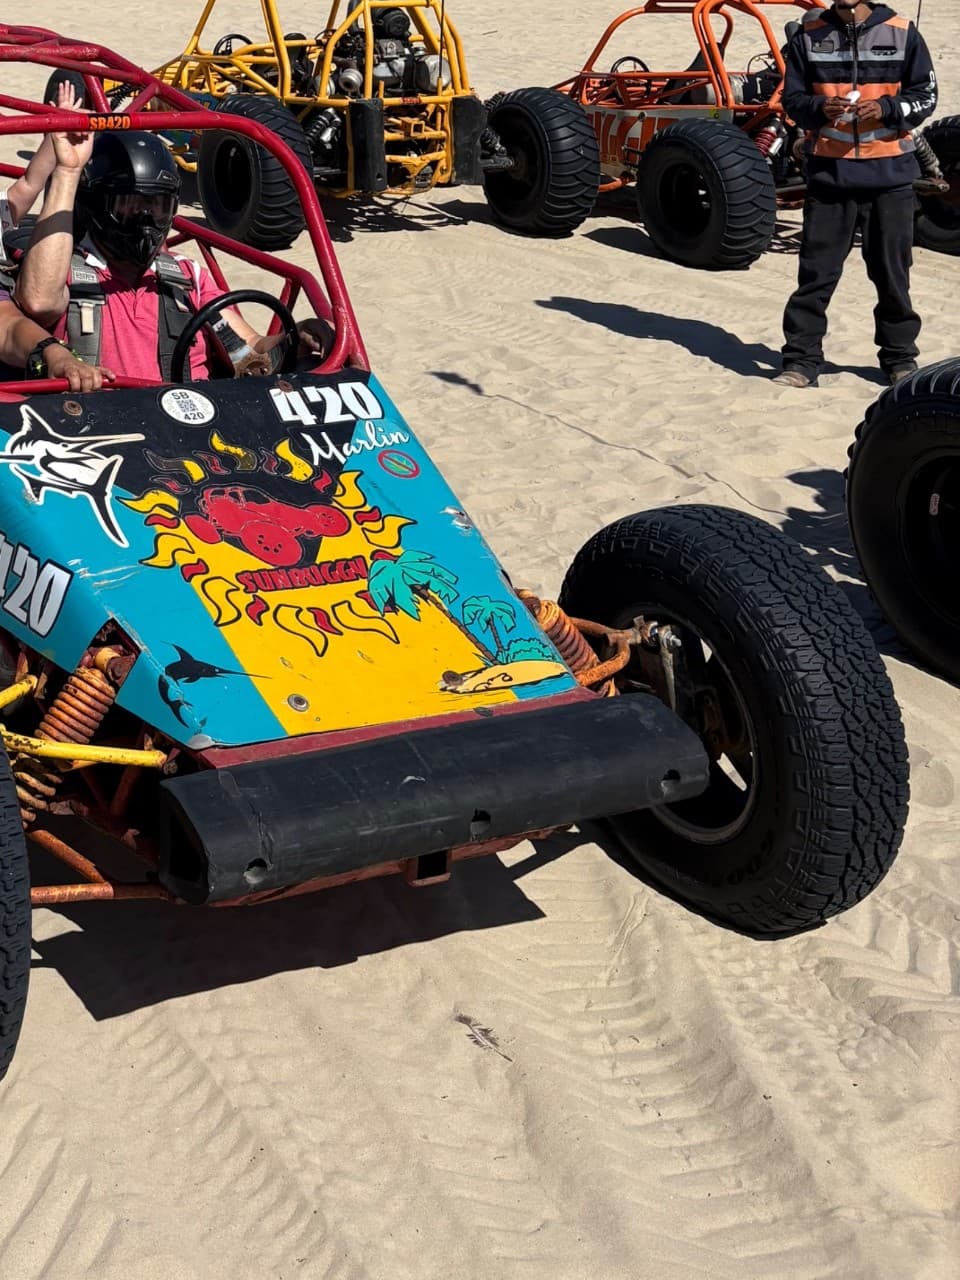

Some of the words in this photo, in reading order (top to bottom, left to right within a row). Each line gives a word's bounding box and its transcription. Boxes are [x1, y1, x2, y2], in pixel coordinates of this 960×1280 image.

[89, 115, 131, 131] SB420
[171, 391, 190, 400] SB
[268, 381, 383, 426] 420
[184, 411, 205, 421] 420
[300, 419, 410, 466] Marlin
[235, 555, 369, 593] SUNBUGGY
